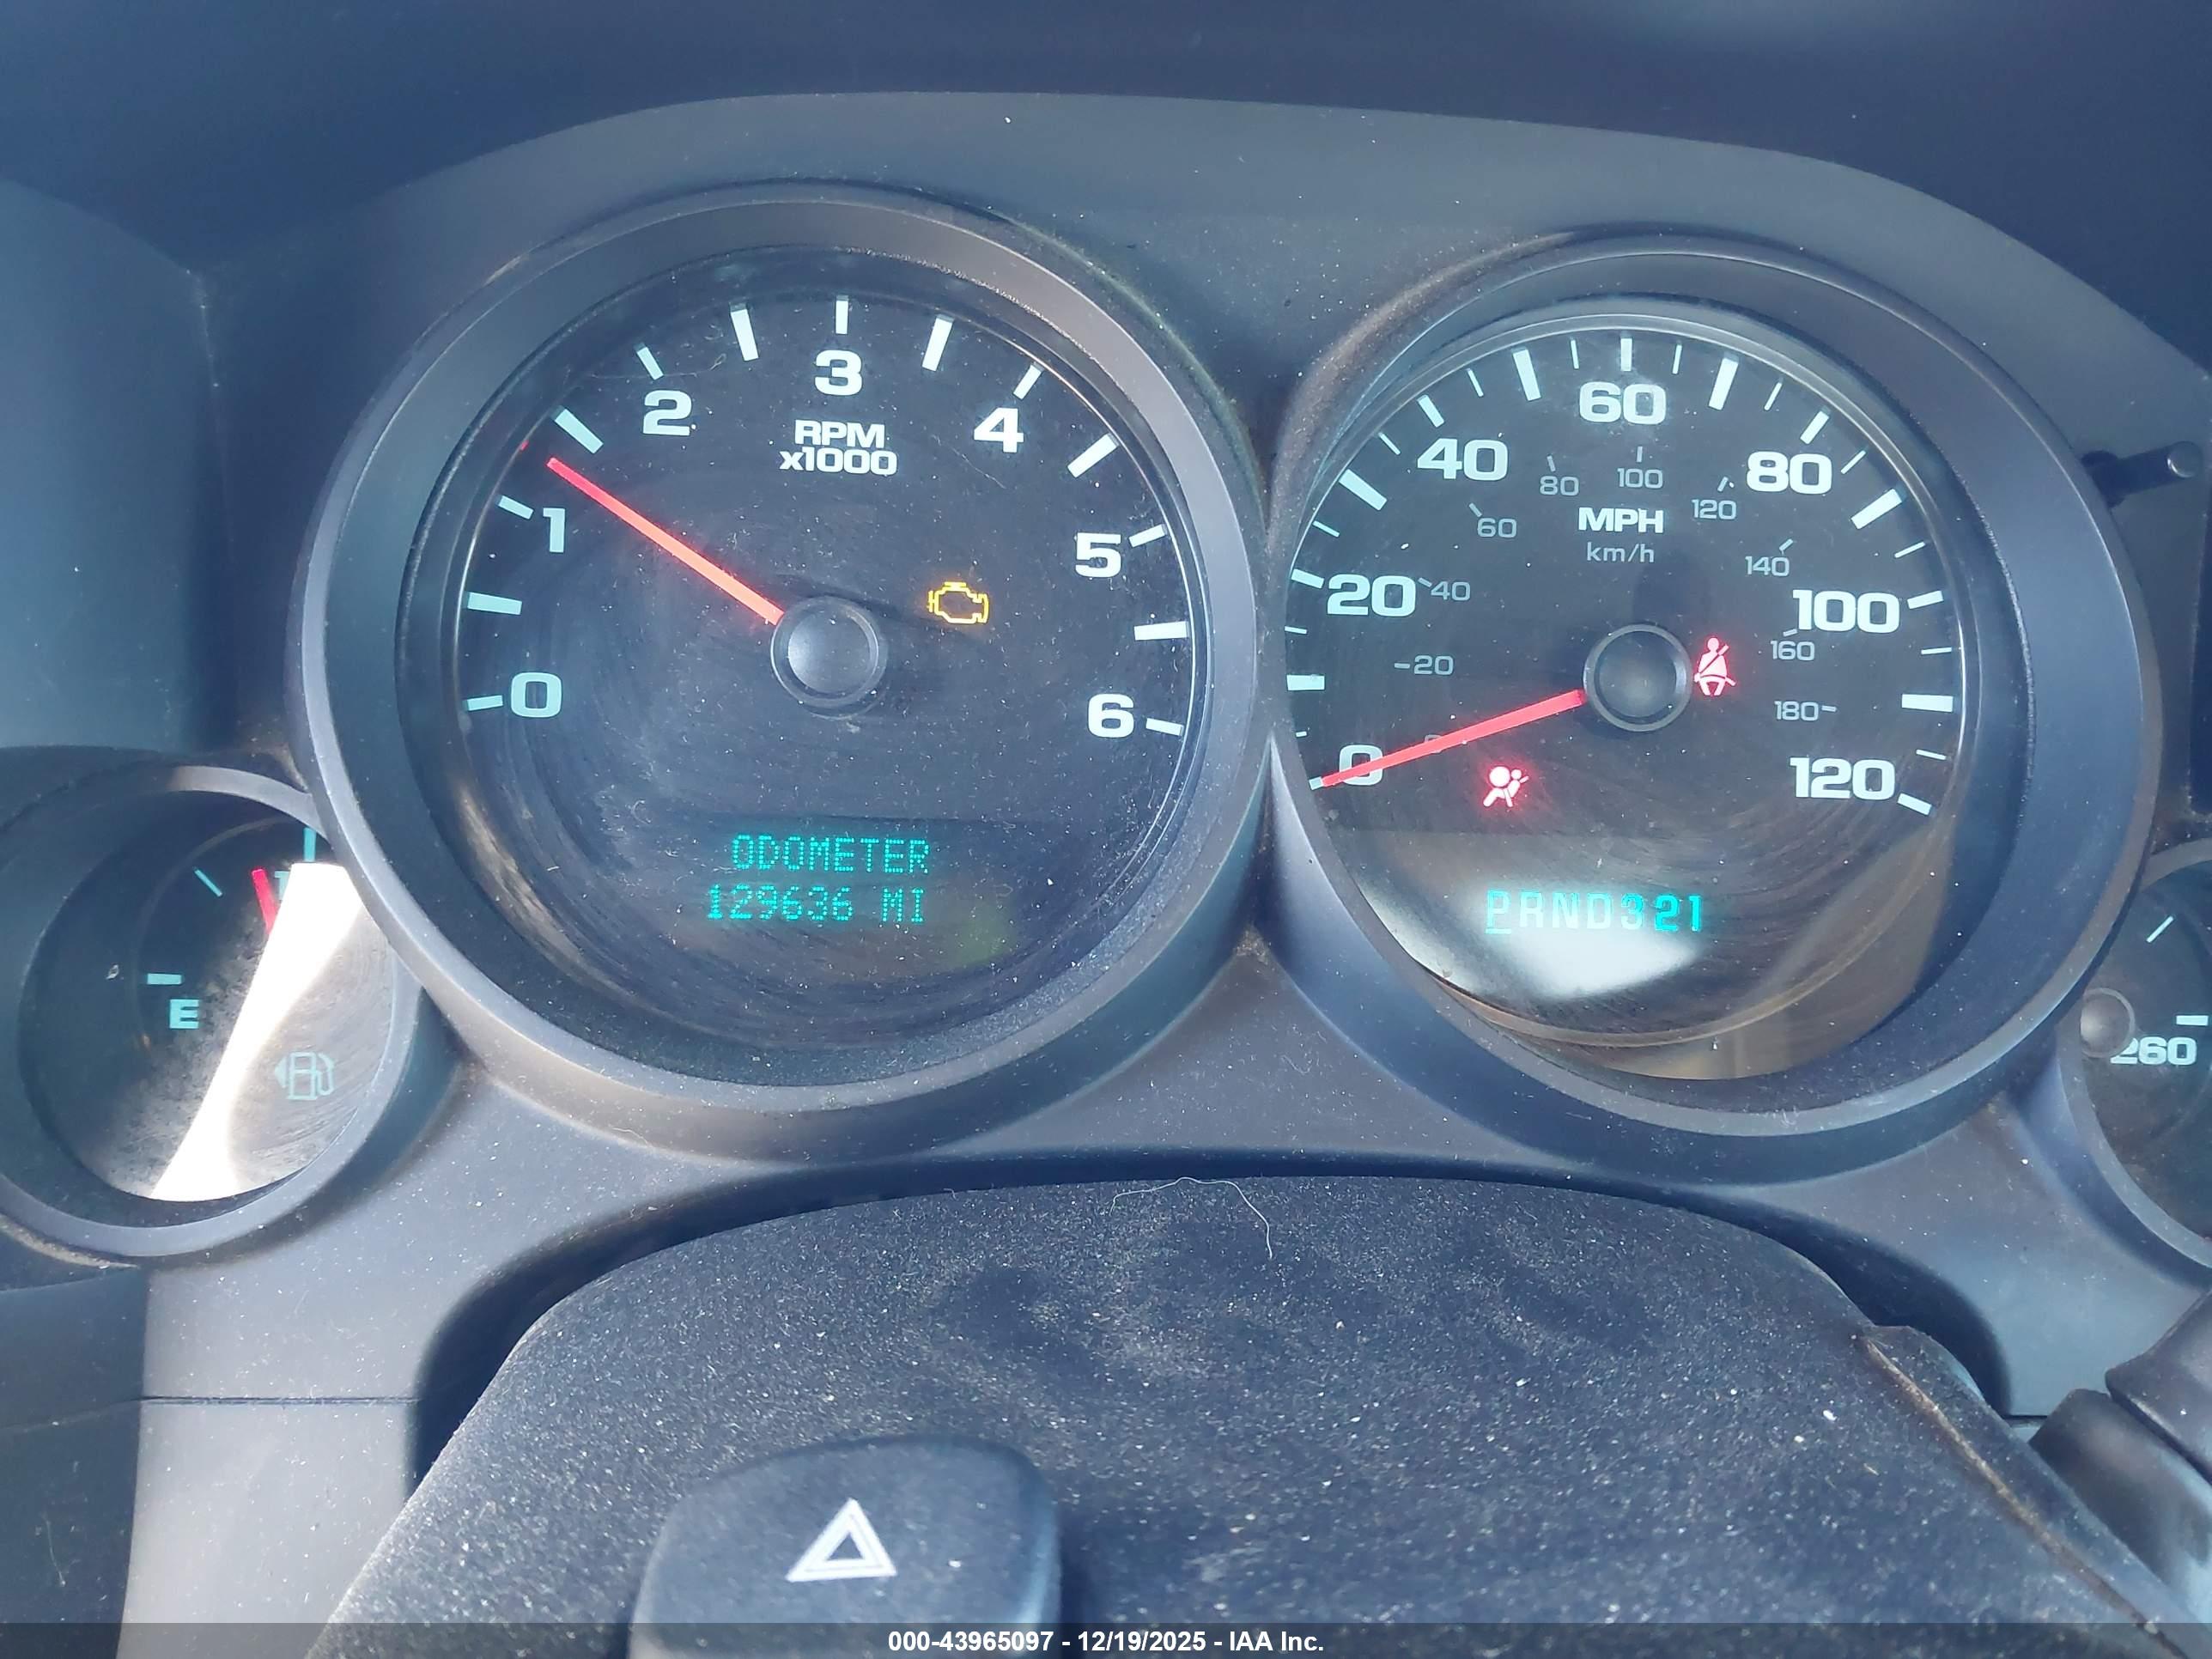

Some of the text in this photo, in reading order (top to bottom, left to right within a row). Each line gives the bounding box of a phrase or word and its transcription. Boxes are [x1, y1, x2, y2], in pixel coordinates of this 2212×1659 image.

[814, 350, 862, 395] 3
[643, 390, 691, 436] 2
[1579, 381, 1667, 425] 60
[793, 421, 884, 447] RPM
[974, 407, 1024, 453] 4
[780, 447, 897, 476] x1000
[1417, 438, 1509, 481] 40
[1617, 467, 1664, 489] 100
[1747, 452, 1832, 495] 80
[1539, 476, 1580, 496] 80
[1477, 518, 1517, 538] 60
[1578, 507, 1664, 532] MPH
[1692, 499, 1737, 521] 120
[542, 507, 566, 553] 1
[1075, 532, 1124, 579] 5
[1586, 543, 1656, 563] km/h
[1746, 556, 1790, 577] 140
[1327, 574, 1416, 617] 20
[1431, 581, 1471, 601] 40
[1793, 589, 1900, 635] 100
[1413, 655, 1455, 676] 20
[1771, 640, 1815, 662] 160
[511, 672, 562, 718] 0
[1775, 701, 1819, 720] 180
[1086, 694, 1134, 738] 6
[1339, 744, 1385, 786] 0
[1790, 757, 1896, 800] 120
[731, 834, 931, 873] ODOMETER
[706, 884, 926, 922] 129636 MI
[169, 998, 200, 1030] E
[2109, 1036, 2197, 1065] 260
